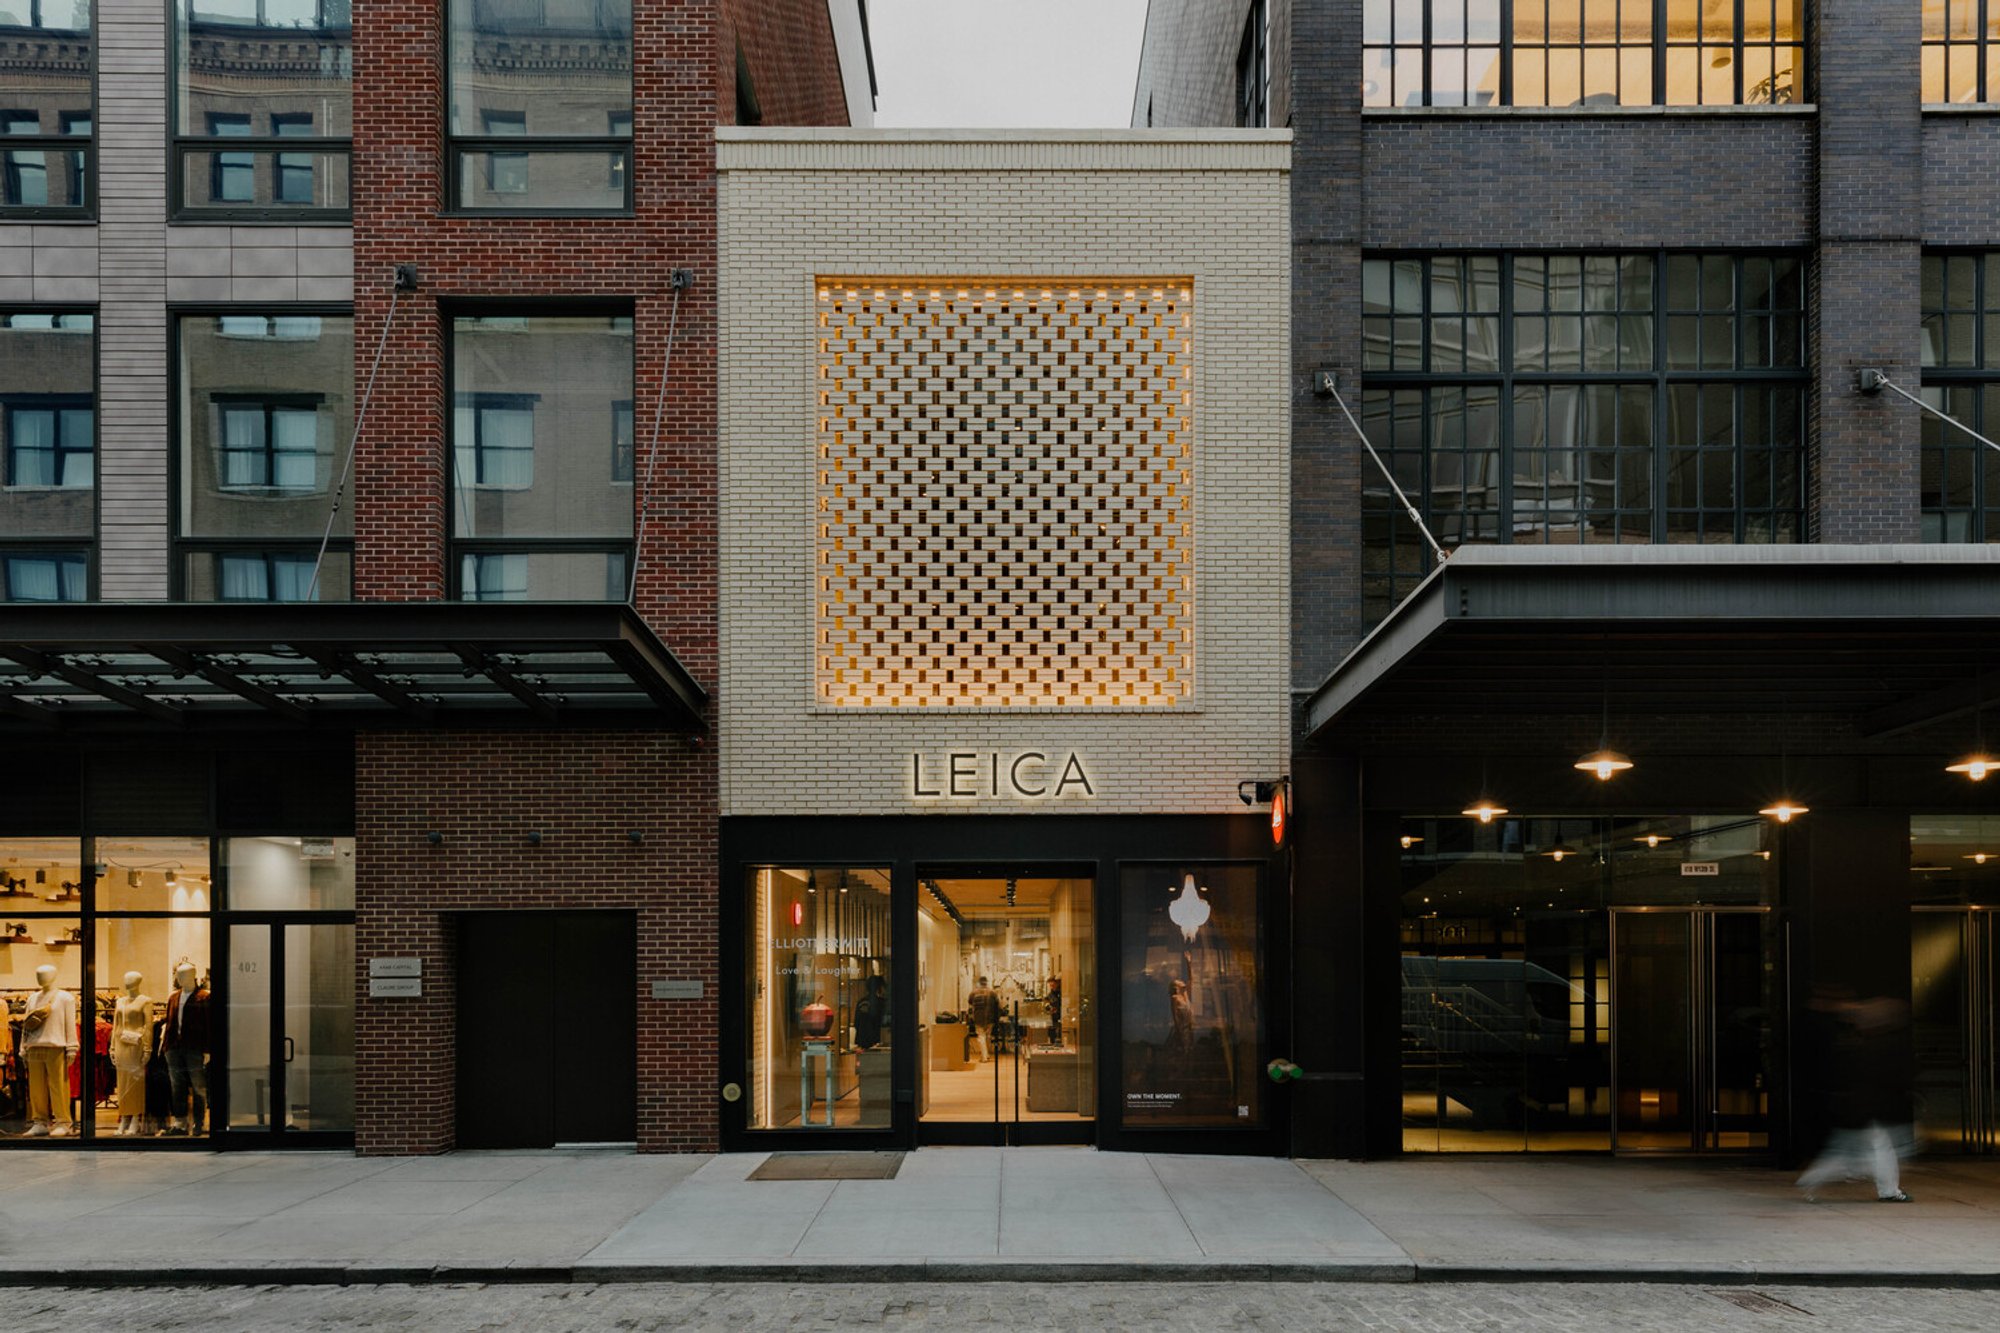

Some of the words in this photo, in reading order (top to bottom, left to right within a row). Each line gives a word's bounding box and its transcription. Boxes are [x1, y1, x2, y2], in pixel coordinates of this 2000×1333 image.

[913, 751, 1094, 796] LEICA
[238, 961, 257, 973] 402
[775, 965, 799, 976] Love
[815, 964, 861, 977] Laughter
